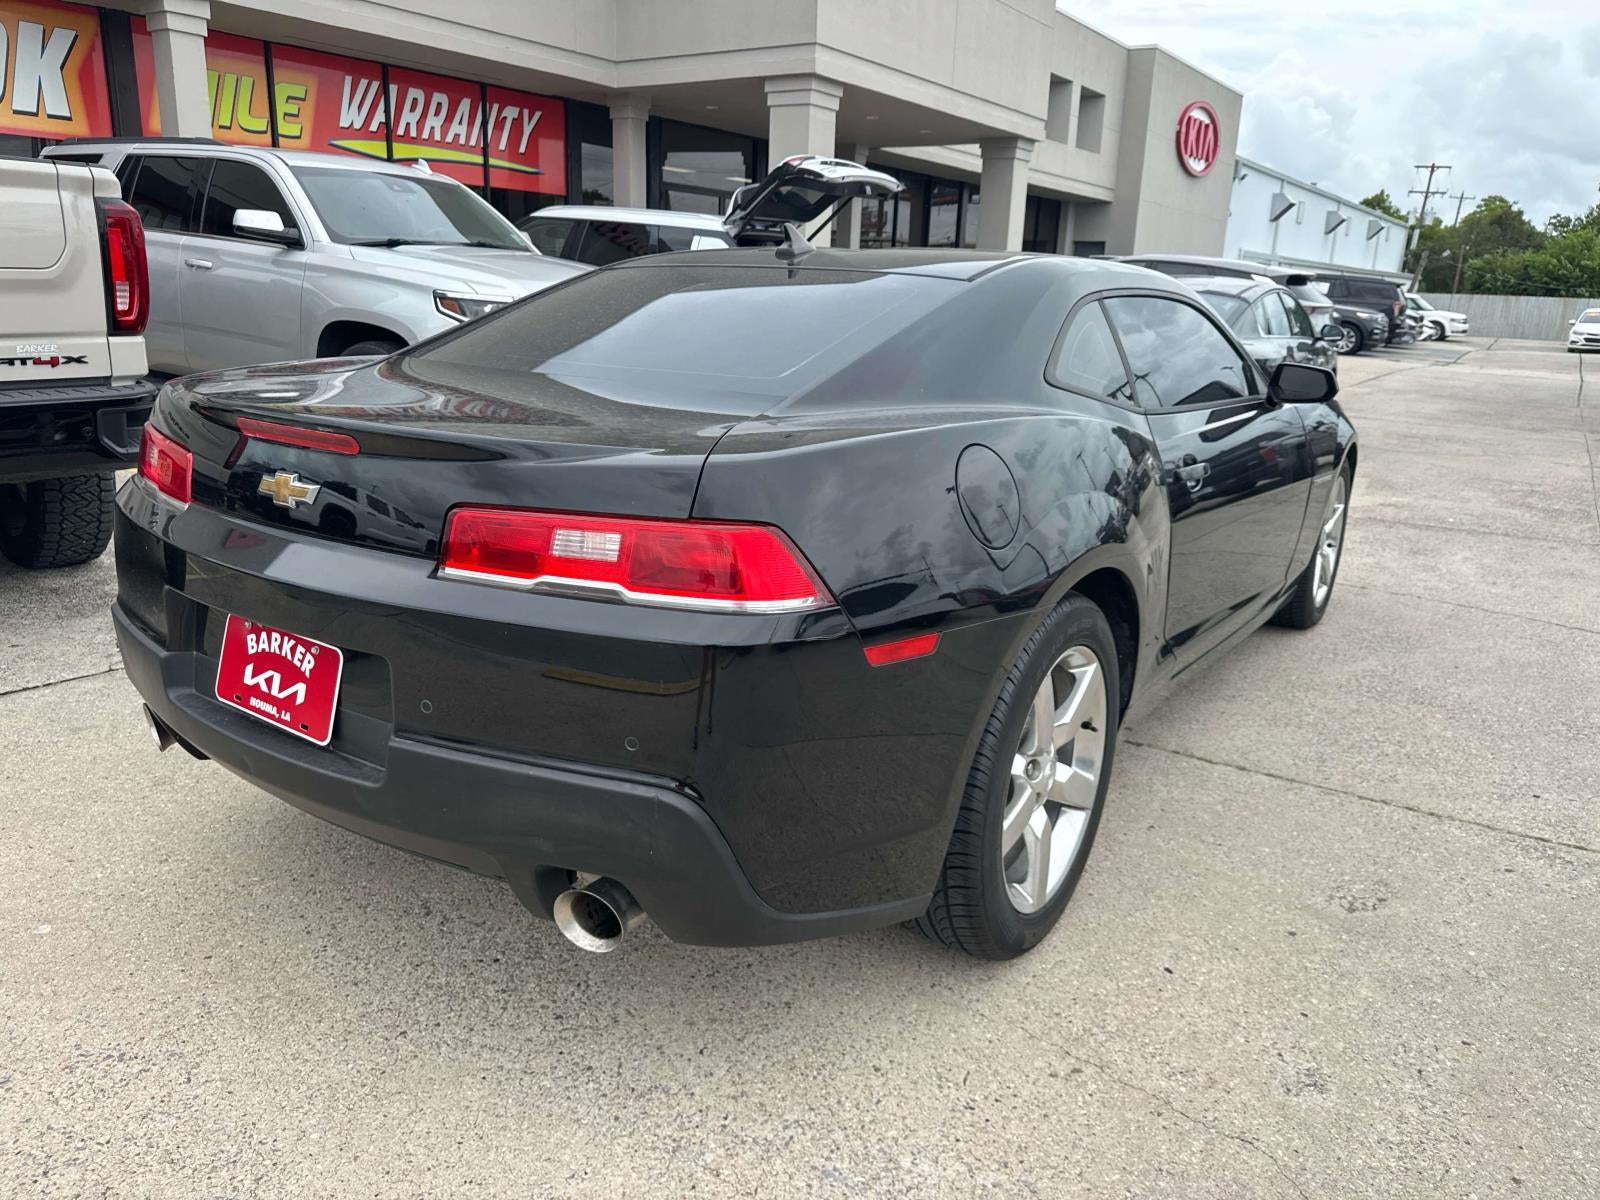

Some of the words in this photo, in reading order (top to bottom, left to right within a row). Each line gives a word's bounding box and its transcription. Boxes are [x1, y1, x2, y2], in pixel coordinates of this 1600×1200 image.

[0, 20, 78, 121] K
[338, 75, 543, 155] WARRANTY
[1187, 116, 1215, 162] KIA
[16, 343, 59, 353] BARKER
[247, 631, 315, 678] BARKER
[243, 662, 307, 706] KIA
[280, 709, 291, 722] LA
